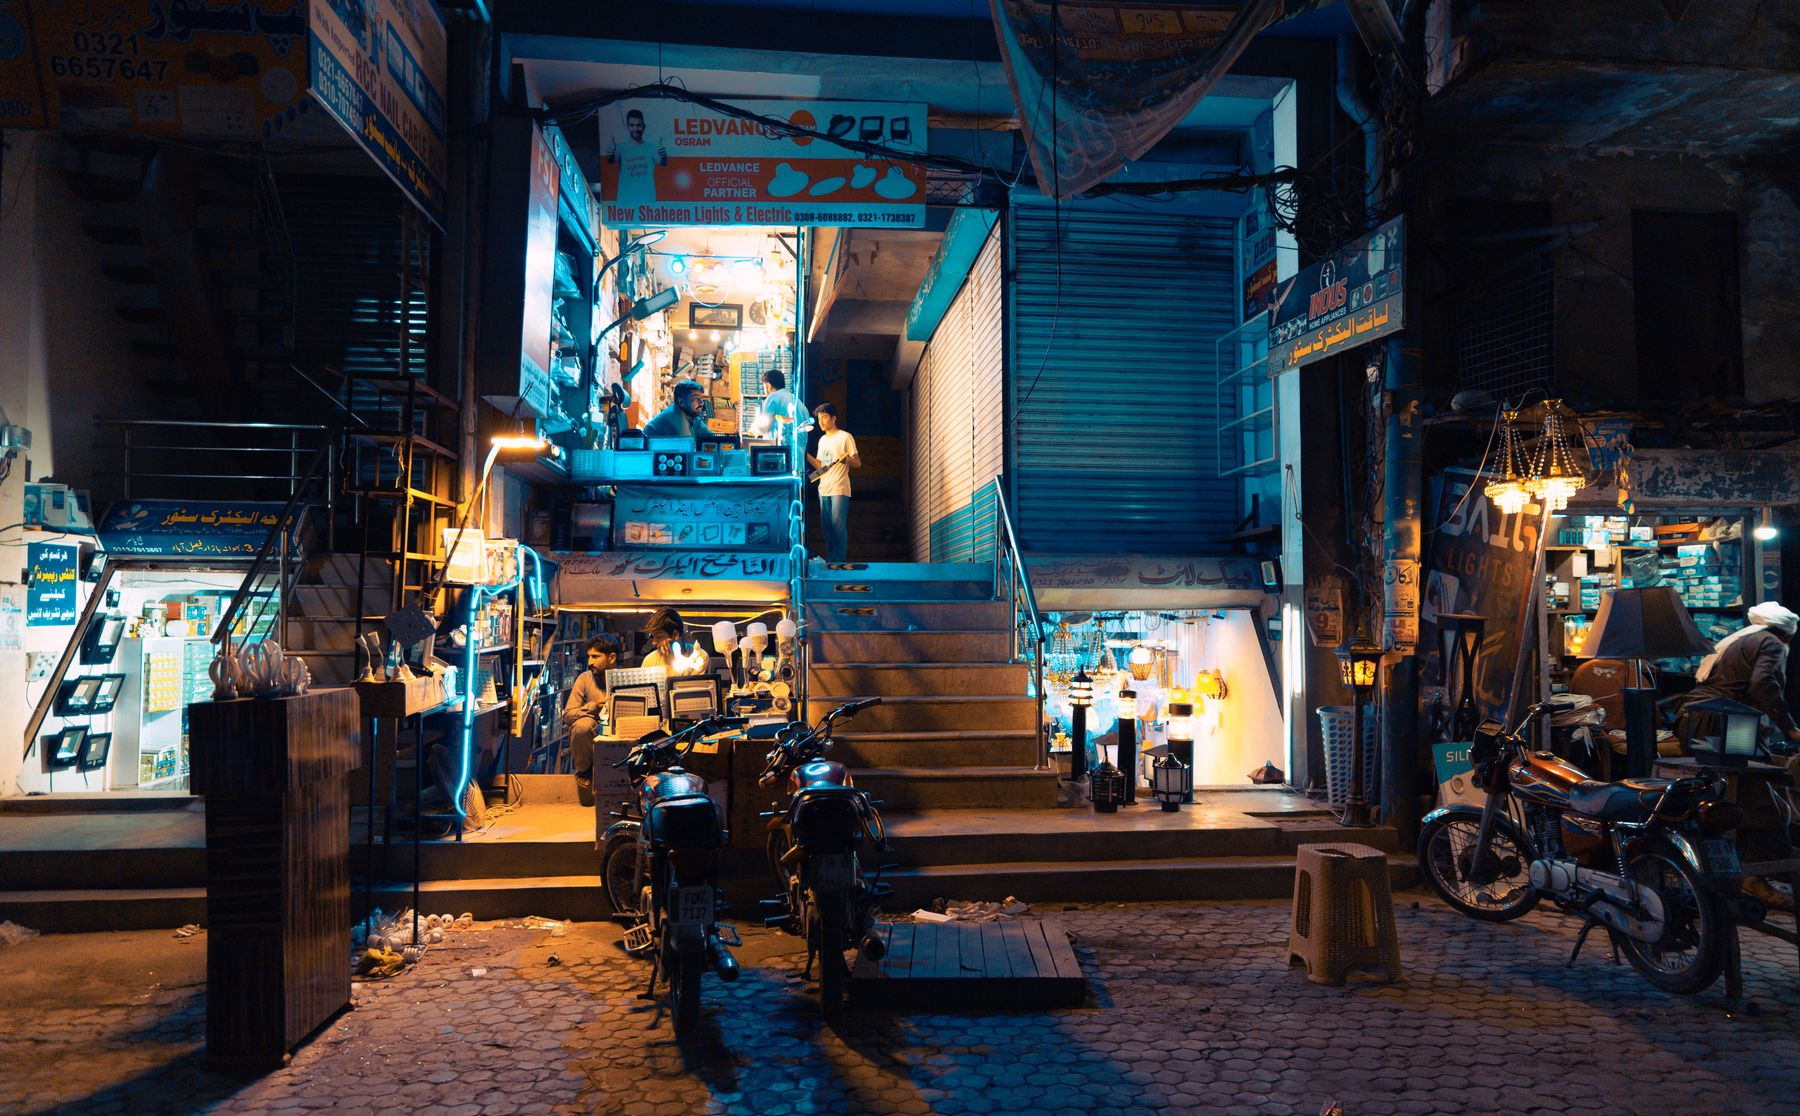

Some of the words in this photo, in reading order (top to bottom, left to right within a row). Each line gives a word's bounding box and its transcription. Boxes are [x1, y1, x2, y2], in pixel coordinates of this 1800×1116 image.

[73, 31, 140, 55] 0321
[50, 55, 168, 82] 6657647
[356, 50, 377, 97] RCC
[380, 81, 400, 130] NAIL
[674, 138, 711, 146] OSRAM
[700, 162, 760, 173] LEDVANCE
[704, 188, 757, 198] PARTNER
[707, 178, 753, 188] OFFICIAL
[608, 206, 635, 222] New
[638, 206, 691, 222] Shaheen
[694, 206, 731, 224] Lights
[734, 207, 743, 222] &
[746, 206, 791, 222] Electric
[1308, 276, 1348, 320] INDUS
[1308, 318, 1320, 330] HOME
[1320, 306, 1347, 326] APPLIANCES
[1313, 316, 1355, 353] الیکٹرک
[1288, 336, 1313, 367] سٹور
[161, 508, 198, 526] سٹور
[200, 509, 259, 527] الیکٹرک
[1447, 547, 1514, 587] LIGHTS
